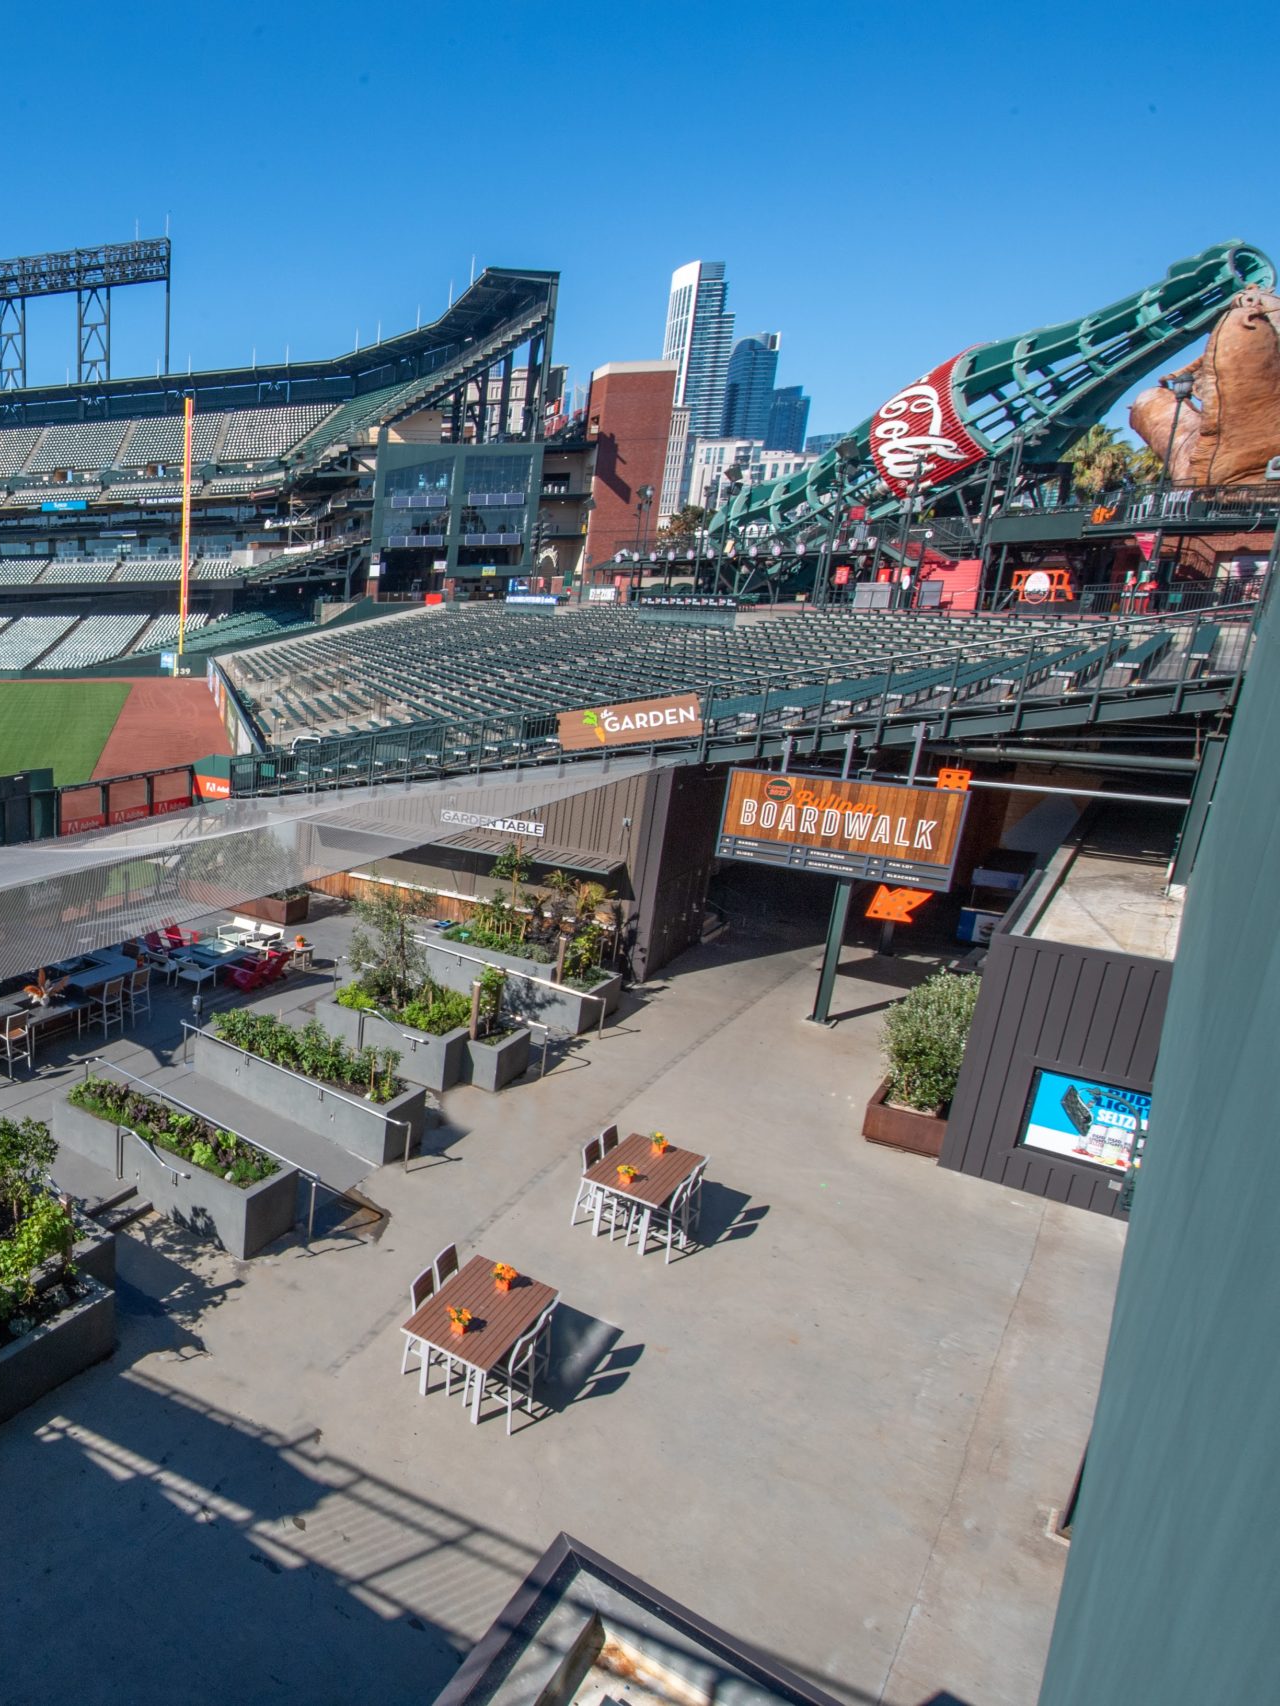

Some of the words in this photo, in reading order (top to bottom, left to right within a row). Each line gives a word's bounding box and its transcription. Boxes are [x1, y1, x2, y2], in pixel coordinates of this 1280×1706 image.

[600, 708, 613, 719] the
[604, 706, 695, 732] GARDEN
[796, 790, 881, 817] Bullpen
[442, 810, 497, 828] GARDEN
[500, 820, 544, 835] TABLE
[740, 799, 937, 850] BOARDWALK
[810, 850, 828, 858] STRIKE
[808, 861, 828, 869] GIANTS
[829, 864, 853, 872] BULLPEN
[886, 873, 920, 882] BLEACHERS
[1097, 1109, 1148, 1131] SELTZ
